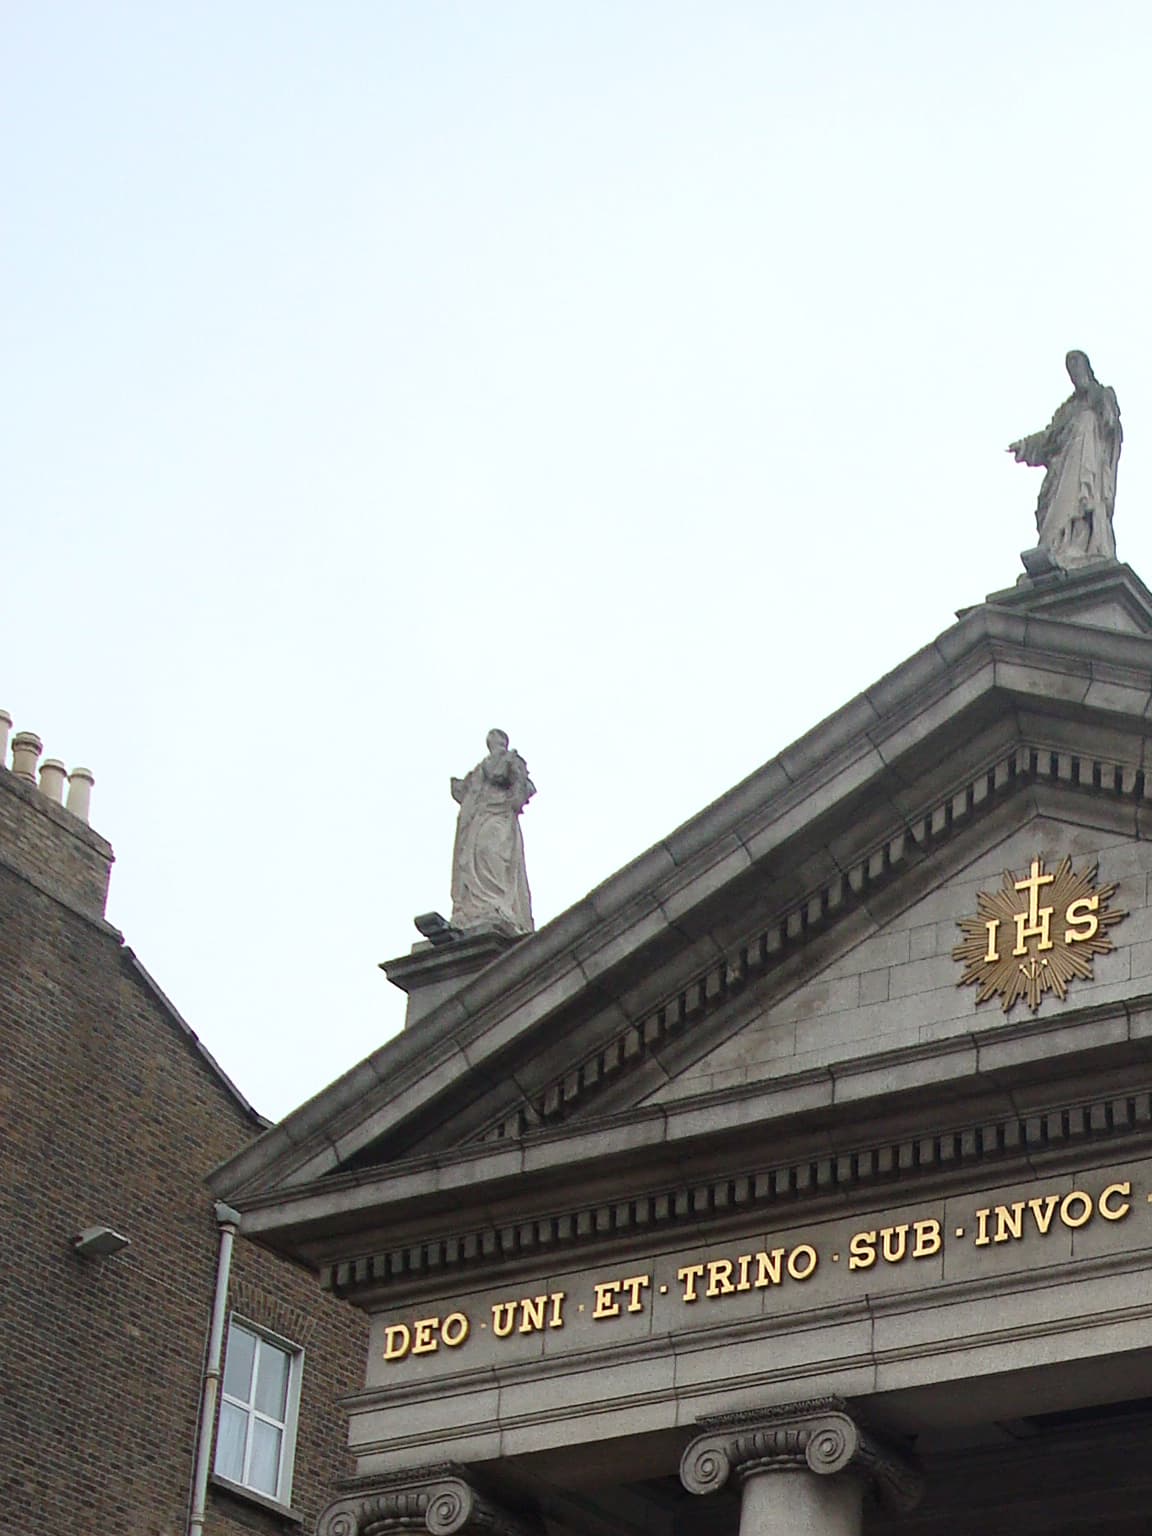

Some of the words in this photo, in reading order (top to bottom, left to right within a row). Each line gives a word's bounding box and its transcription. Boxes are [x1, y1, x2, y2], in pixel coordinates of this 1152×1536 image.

[983, 895, 1100, 963] IHS
[382, 1312, 469, 1361] DEO
[490, 1292, 565, 1337] UNI
[591, 1275, 650, 1320] ET
[677, 1244, 818, 1303] TRINO
[847, 1218, 942, 1270] SUB
[975, 1181, 1132, 1247] INVOC
